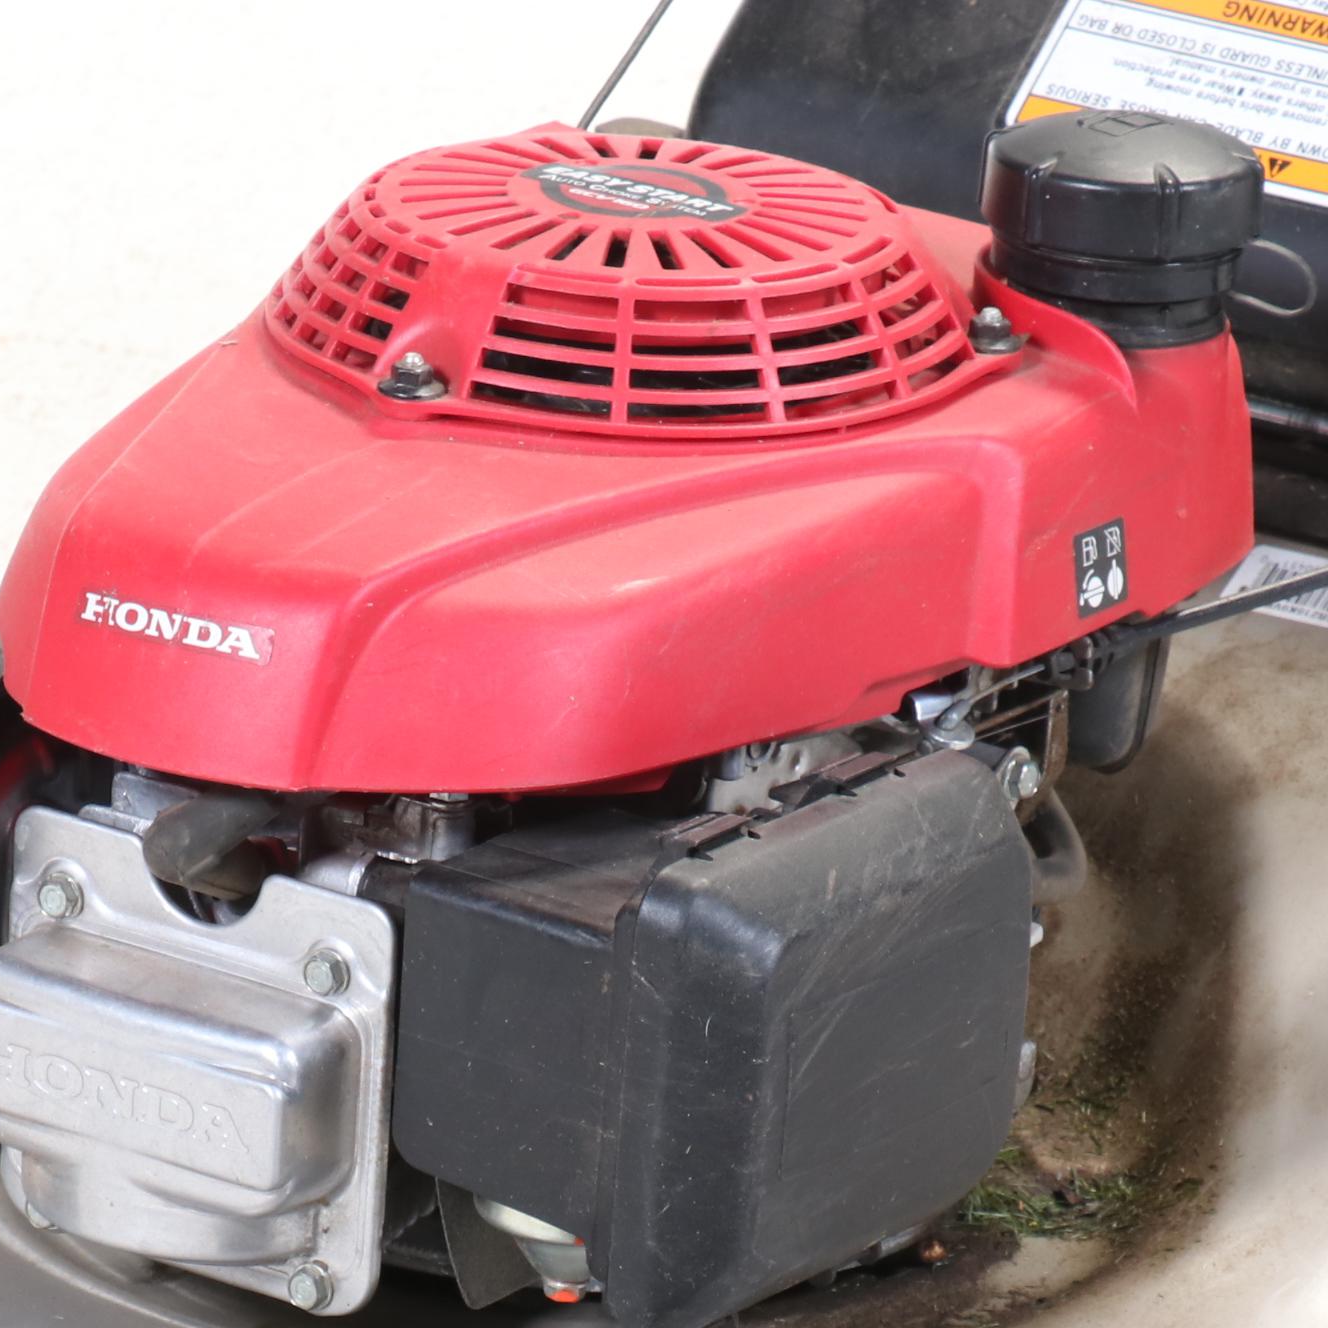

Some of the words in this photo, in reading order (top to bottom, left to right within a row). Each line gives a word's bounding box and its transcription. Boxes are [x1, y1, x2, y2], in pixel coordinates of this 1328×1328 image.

[1077, 14, 1107, 30] BAG
[1111, 22, 1134, 36] OR
[1136, 28, 1197, 50] CLOSED
[1200, 42, 1215, 54] IS
[1218, 46, 1271, 67] GUARD
[1045, 83, 1110, 107] SERIOUS
[1269, 135, 1291, 149] BY
[541, 165, 633, 187] EASY
[626, 181, 734, 213] START
[80, 592, 260, 660] HONDA
